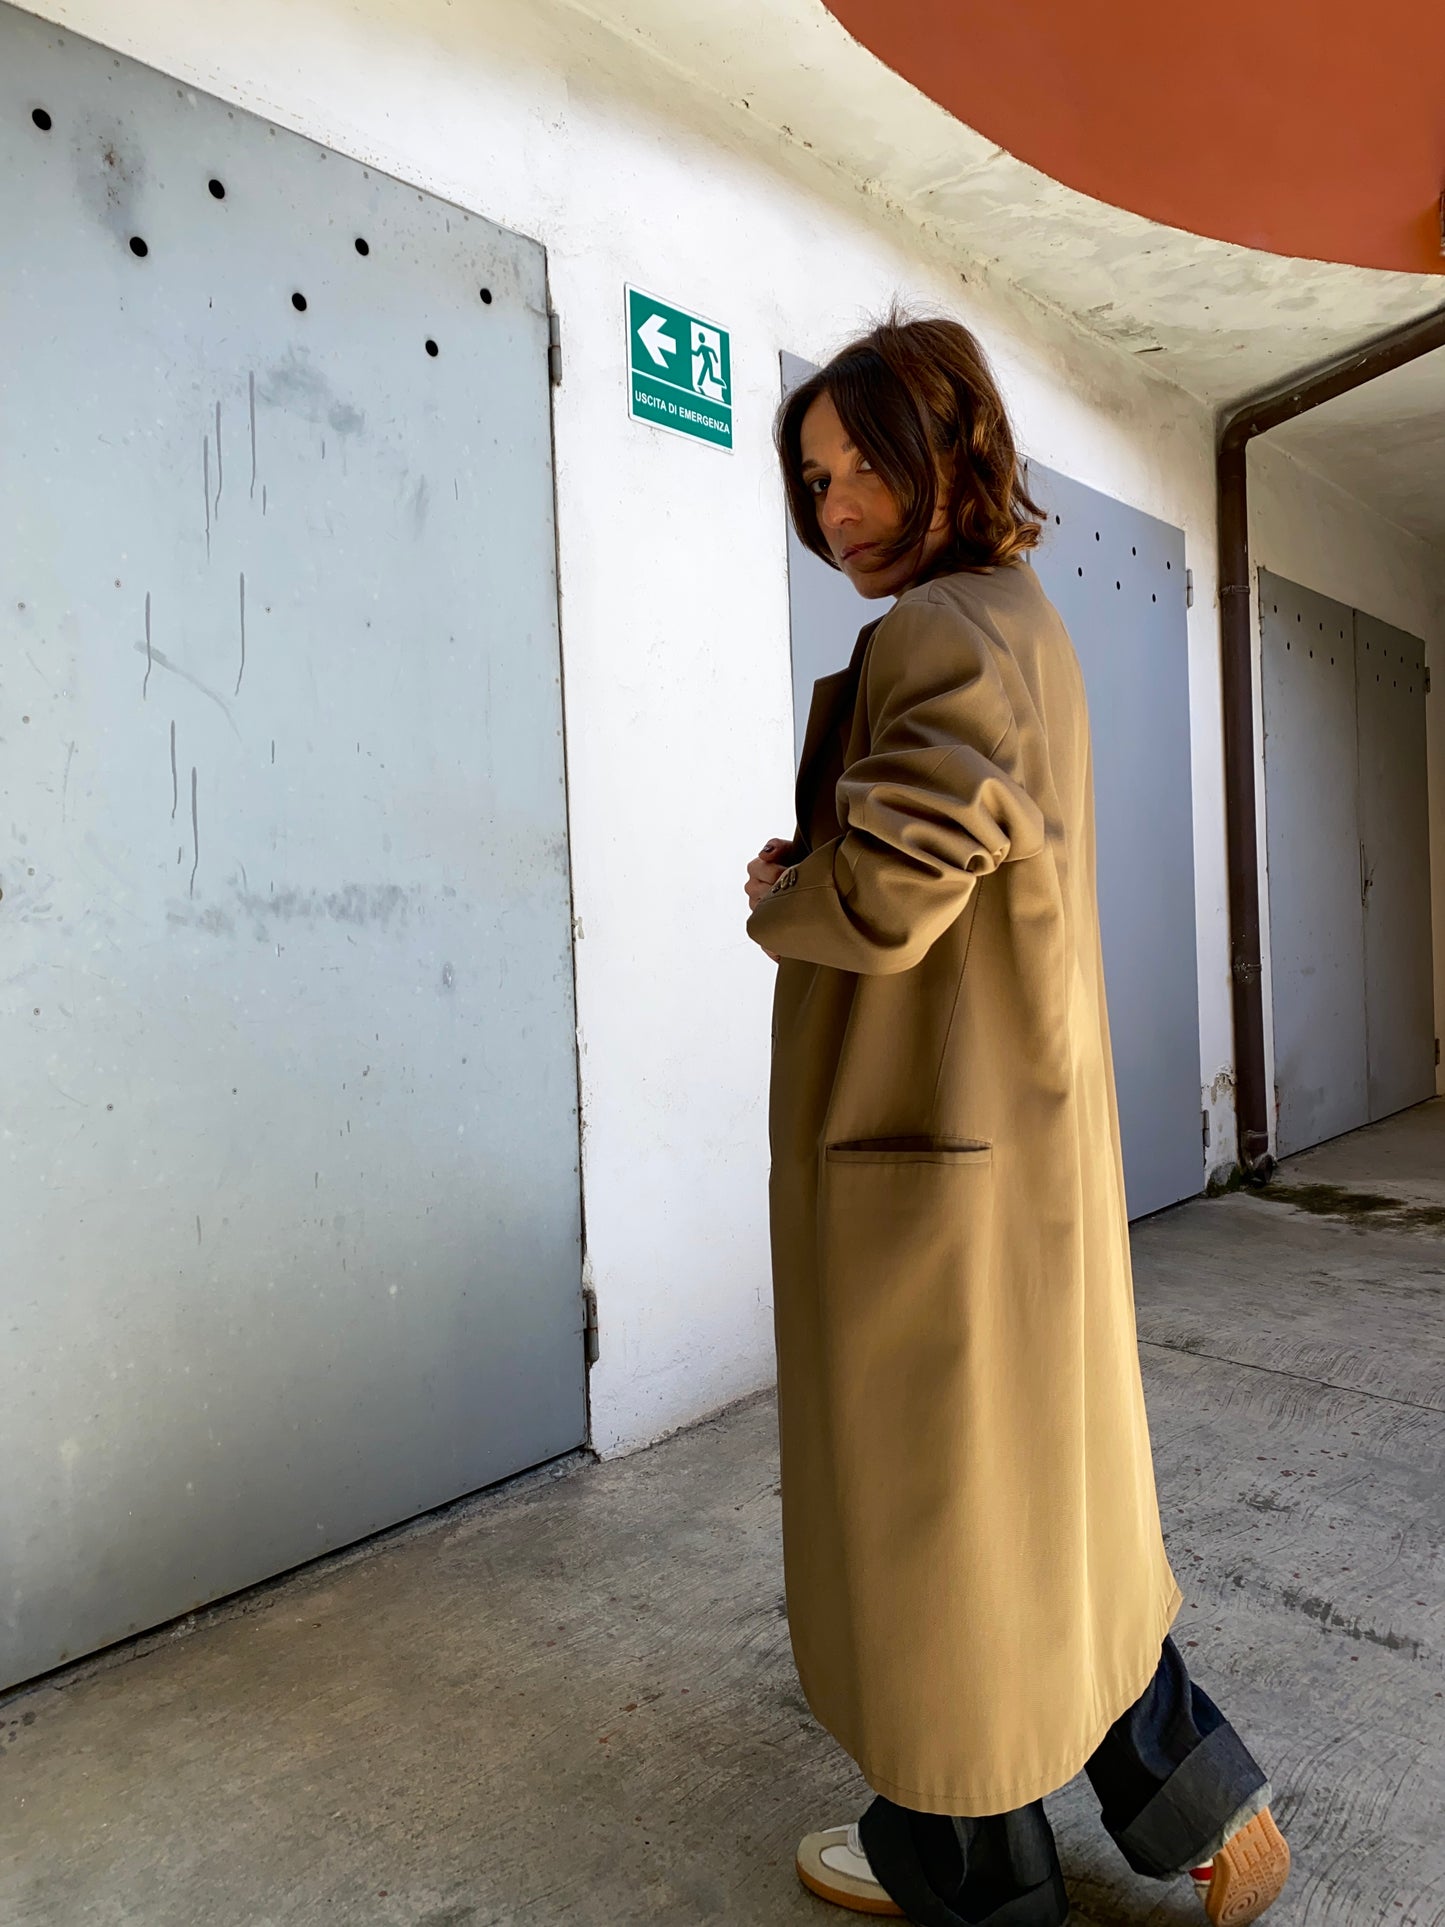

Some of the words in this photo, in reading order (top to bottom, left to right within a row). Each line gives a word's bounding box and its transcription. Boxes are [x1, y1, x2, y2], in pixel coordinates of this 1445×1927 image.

[635, 390, 667, 411] USCITA
[669, 403, 677, 415] DI
[679, 406, 730, 434] EMERGENZA
